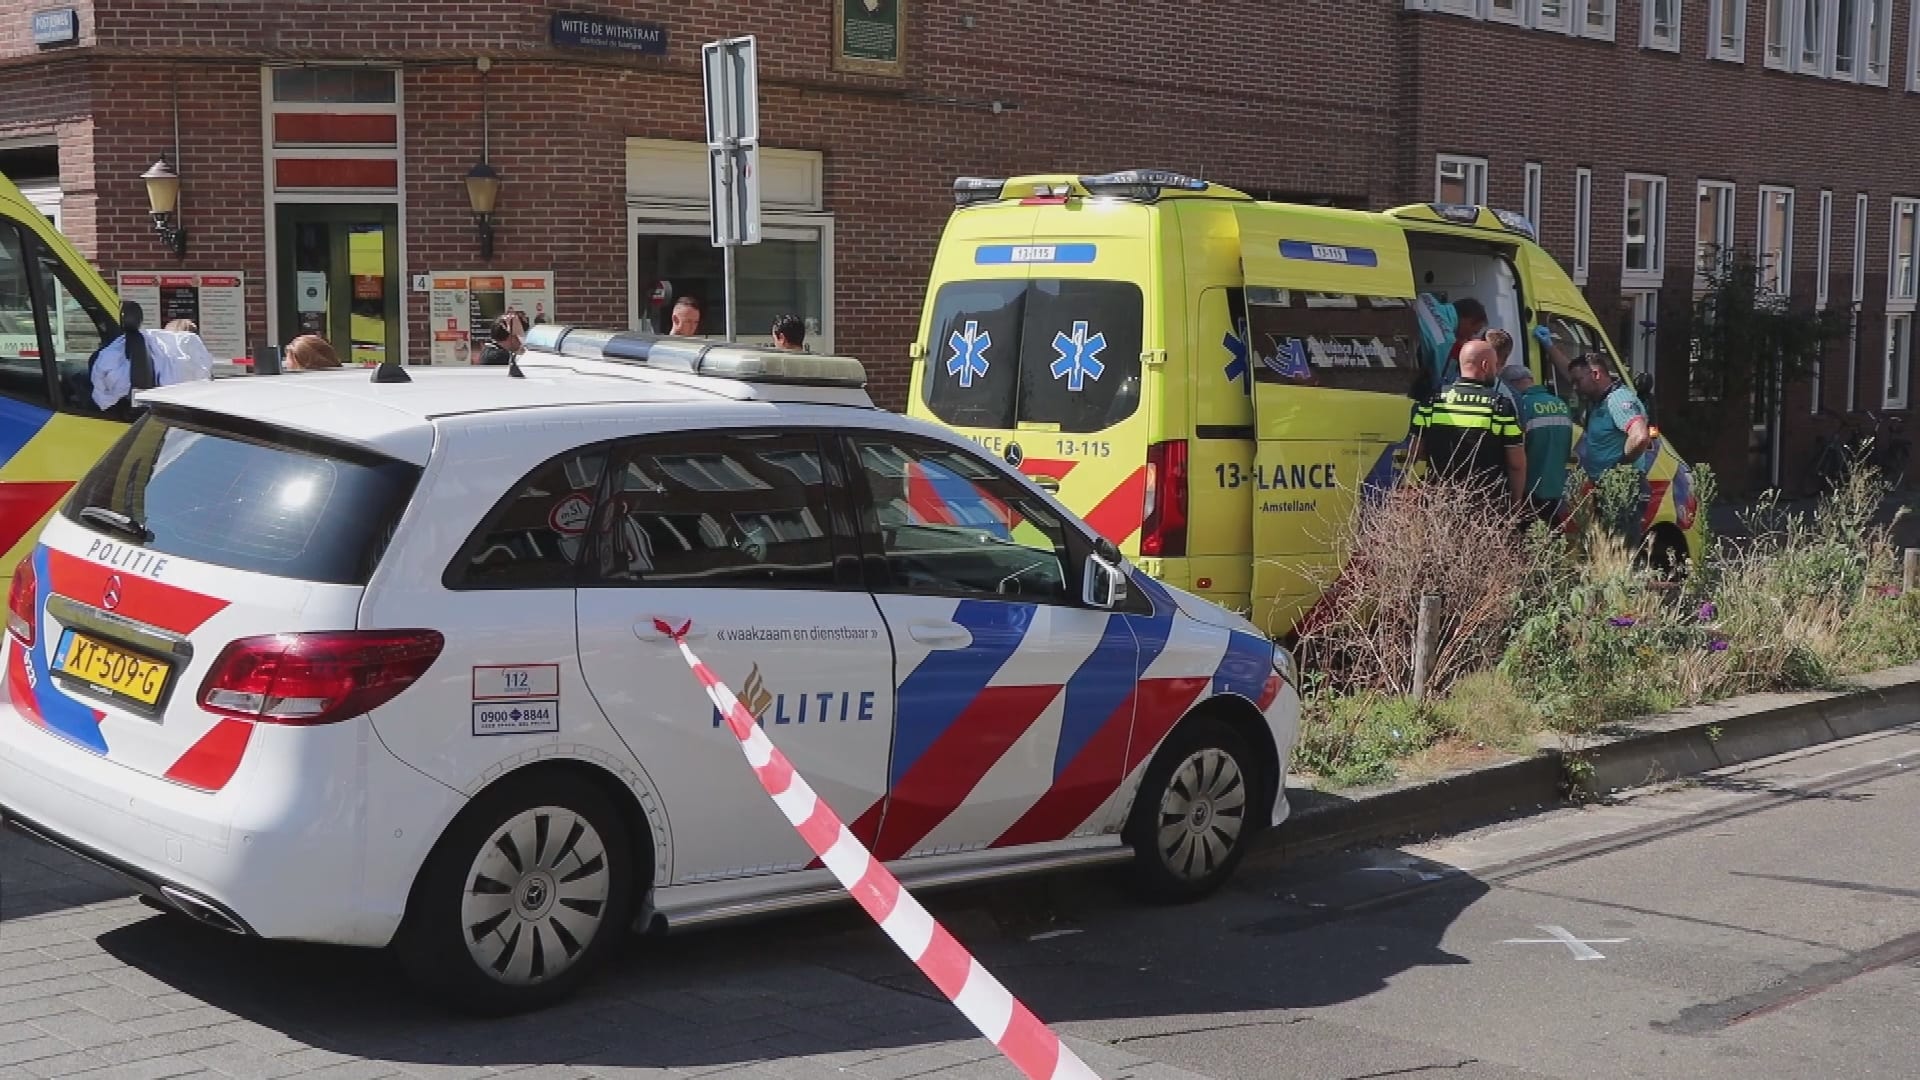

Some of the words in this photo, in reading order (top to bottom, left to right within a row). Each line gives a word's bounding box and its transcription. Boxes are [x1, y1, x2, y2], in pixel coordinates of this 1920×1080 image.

[561, 20, 589, 34] WITTE
[591, 23, 602, 36] DE
[605, 25, 659, 42] WITHSTRAAT
[417, 276, 426, 290] 4
[964, 434, 1001, 451] NCE
[1055, 439, 1110, 457] 13-115
[86, 538, 168, 578] POLITIE
[728, 626, 792, 641] waakzaam
[794, 629, 808, 641] en
[811, 626, 869, 641] dienstbaar
[70, 638, 160, 695] XT-509-G
[505, 672, 528, 687] 112
[481, 711, 508, 722] 0900
[523, 708, 549, 721] 8844
[712, 691, 875, 729] LITIE
